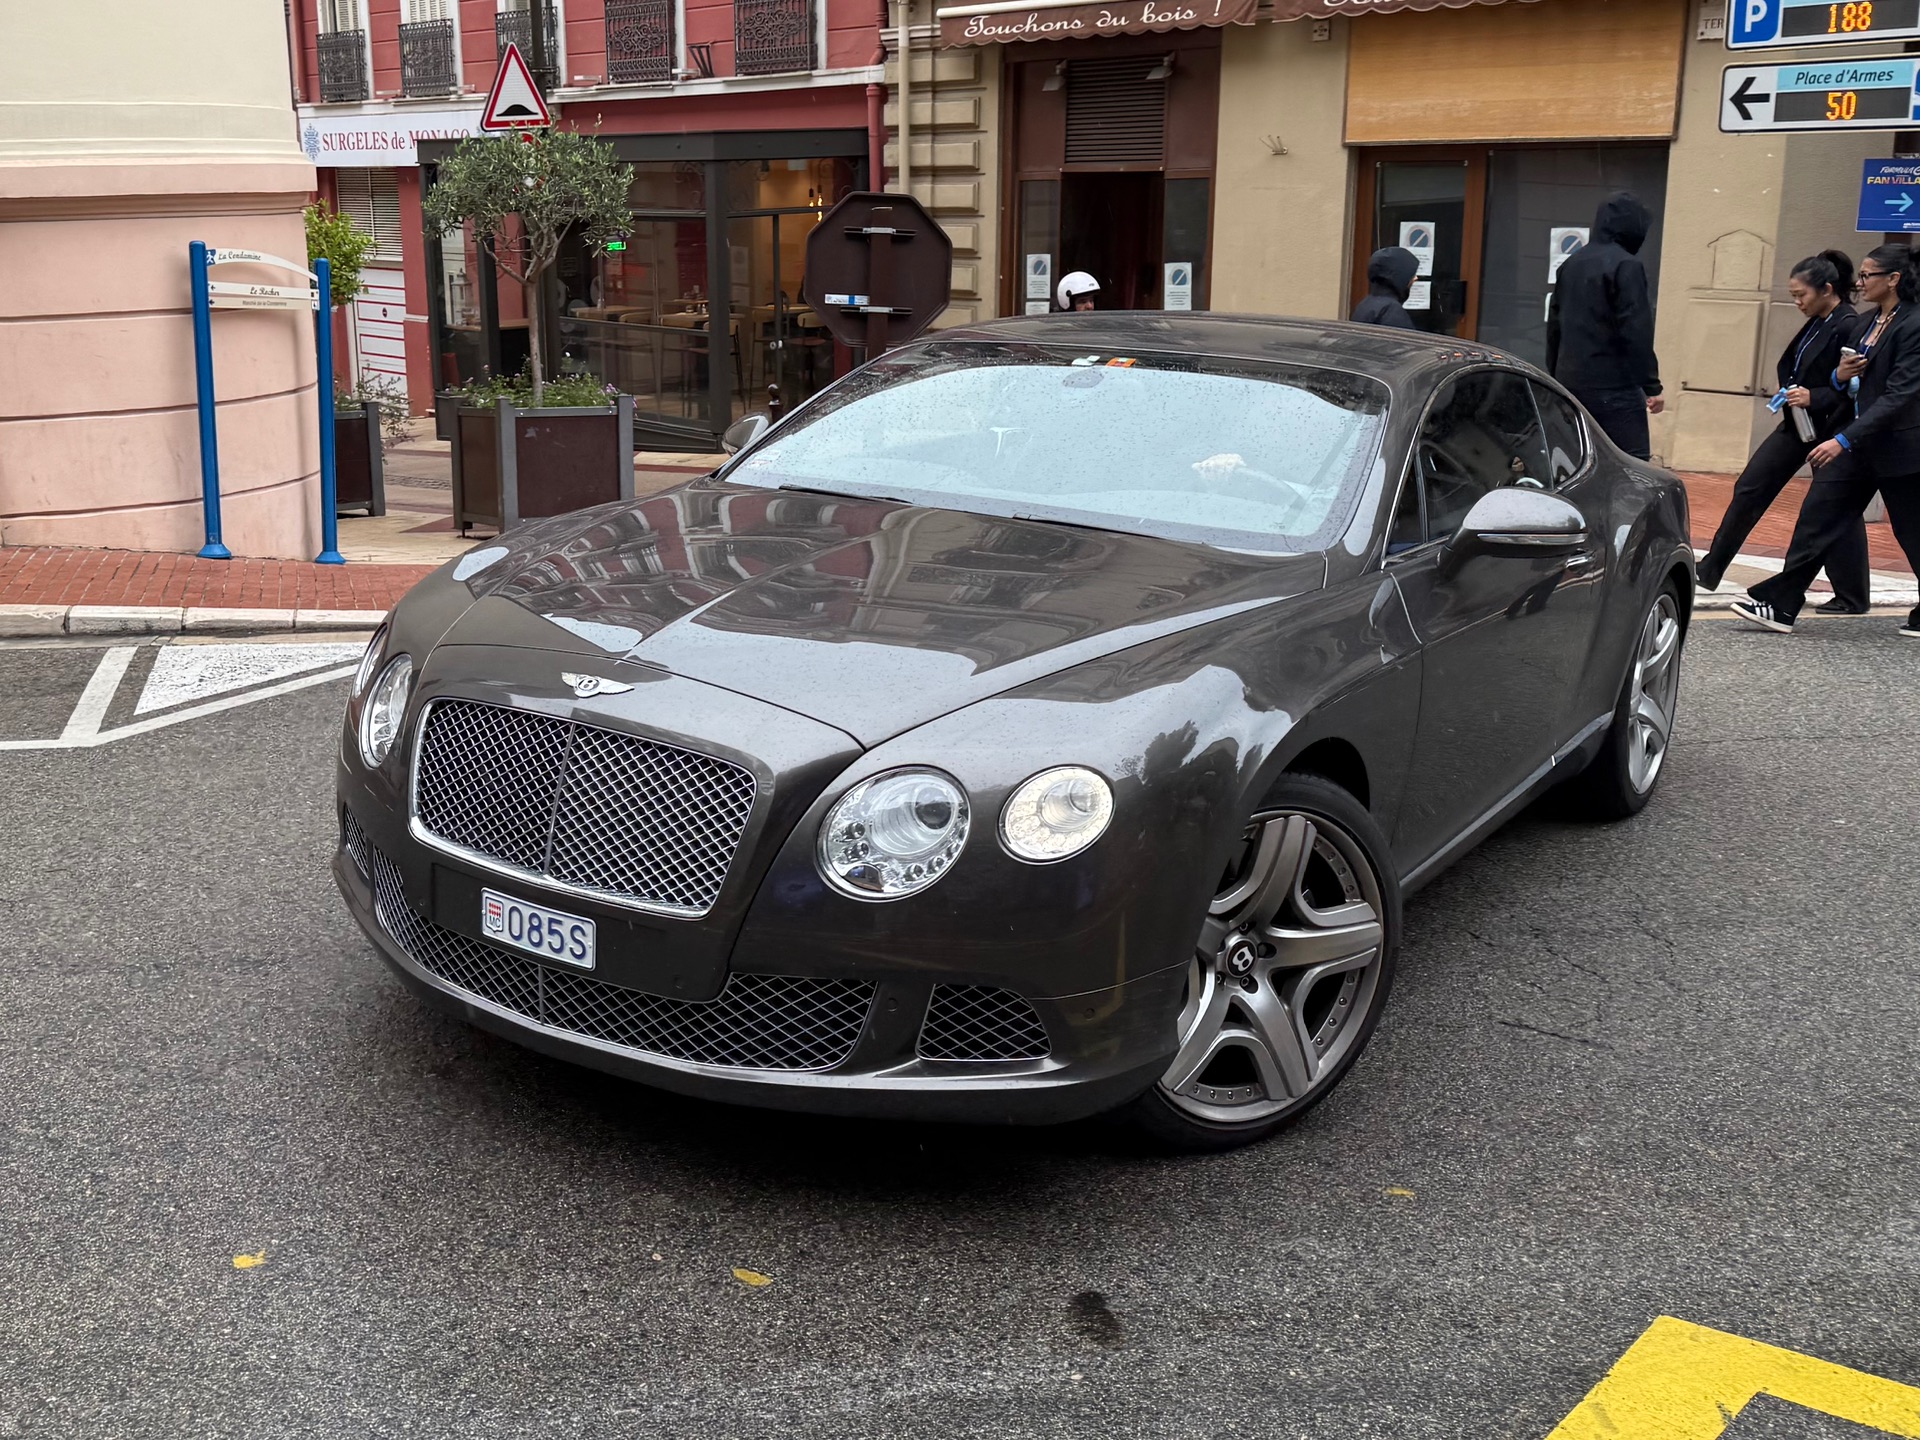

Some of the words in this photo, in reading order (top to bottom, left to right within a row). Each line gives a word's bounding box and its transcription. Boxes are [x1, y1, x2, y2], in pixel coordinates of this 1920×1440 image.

[964, 14, 1085, 38] Touchons
[1094, 10, 1130, 28] du
[1139, 1, 1197, 22] bois
[1744, 0, 1768, 33] P
[1827, 1, 1873, 33] 188
[1794, 70, 1832, 86] Place
[1835, 69, 1894, 84] d'Armes
[1826, 91, 1857, 120] 50
[322, 131, 389, 151] SURGELES
[391, 131, 405, 149] de
[1867, 176, 1890, 185] FAN
[218, 253, 227, 261] La
[228, 251, 261, 261] Condamine
[250, 286, 257, 295] Le
[489, 915, 501, 928] MC
[508, 905, 587, 960] 085S
